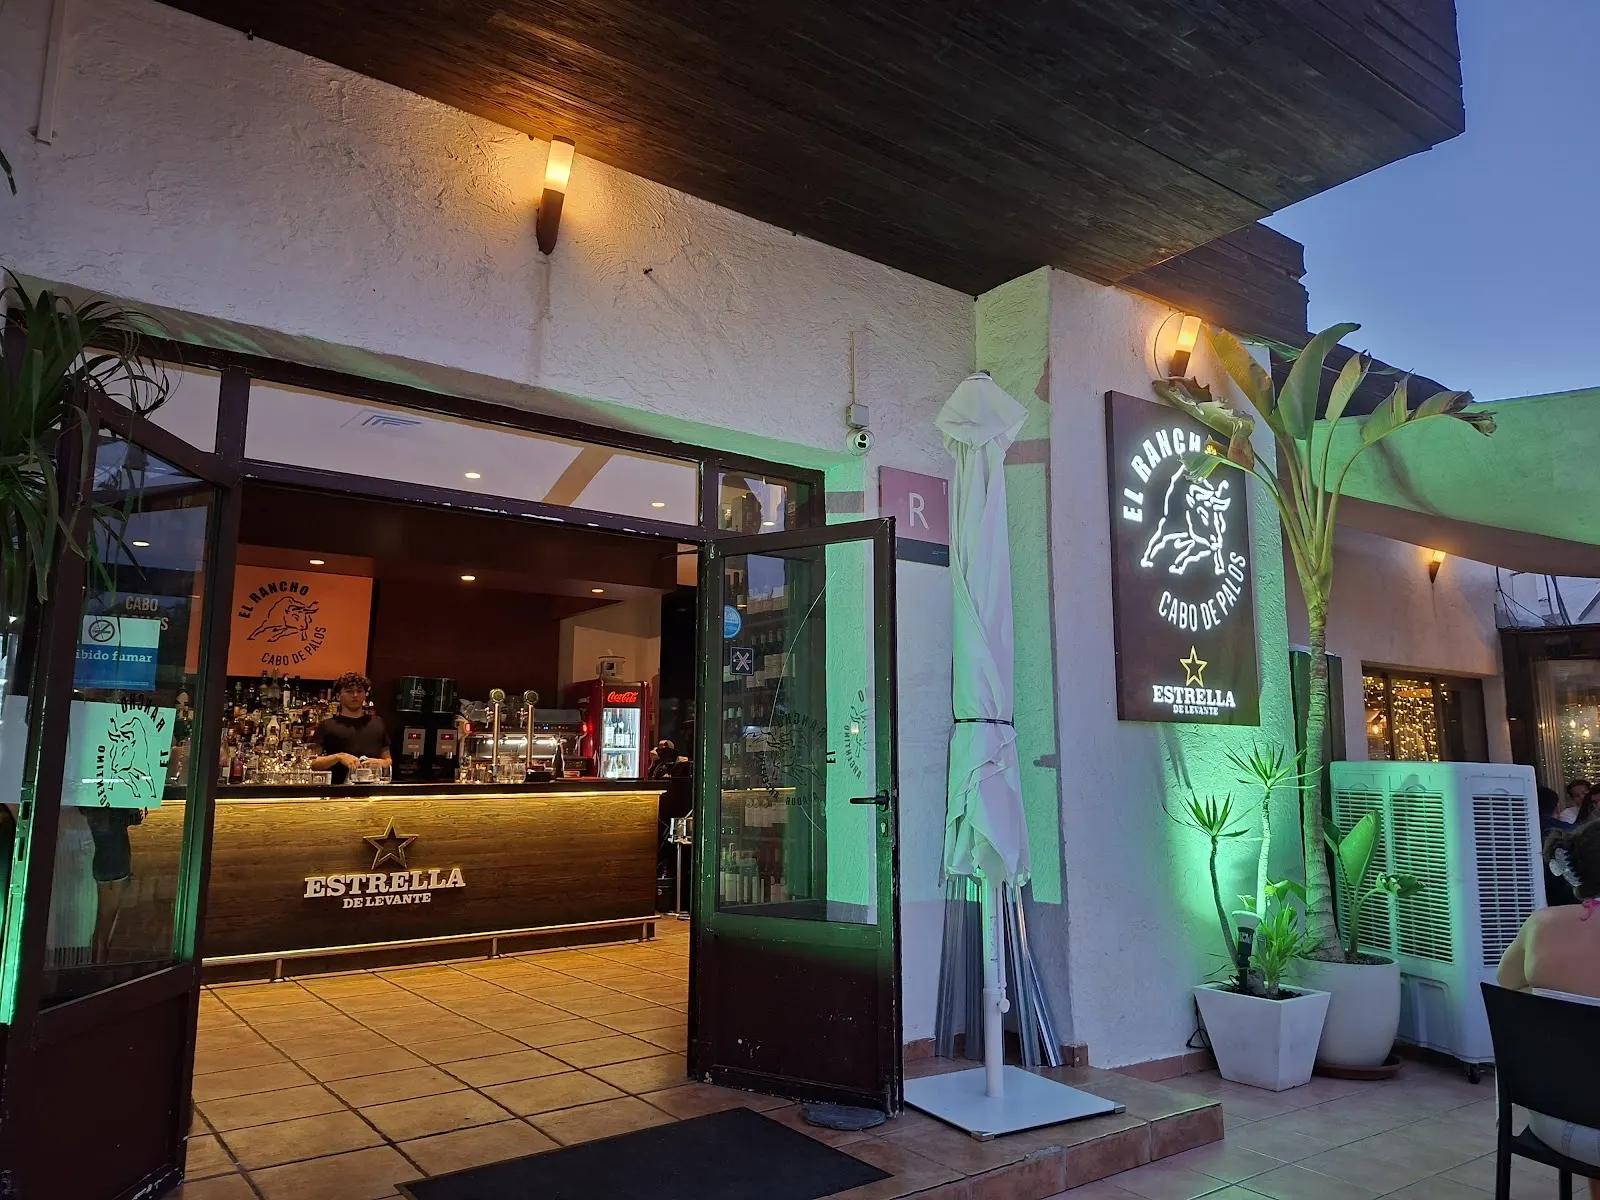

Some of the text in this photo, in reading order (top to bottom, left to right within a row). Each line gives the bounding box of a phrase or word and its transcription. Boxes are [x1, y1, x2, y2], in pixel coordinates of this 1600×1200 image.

[1123, 428, 1201, 522] EL RANCH
[909, 492, 930, 530] R
[125, 596, 159, 612] CABO
[238, 581, 310, 619] EL RANCHO
[1158, 552, 1246, 632] CABO DE PALOS
[75, 650, 153, 663] ibido fumar
[261, 626, 327, 666] CABO DE PALOS
[1152, 685, 1236, 708] ESTRELLA
[1173, 704, 1219, 716] DE LEVANTE
[303, 867, 467, 899] ESTRELLA
[342, 893, 432, 909] DE LEVANTE
